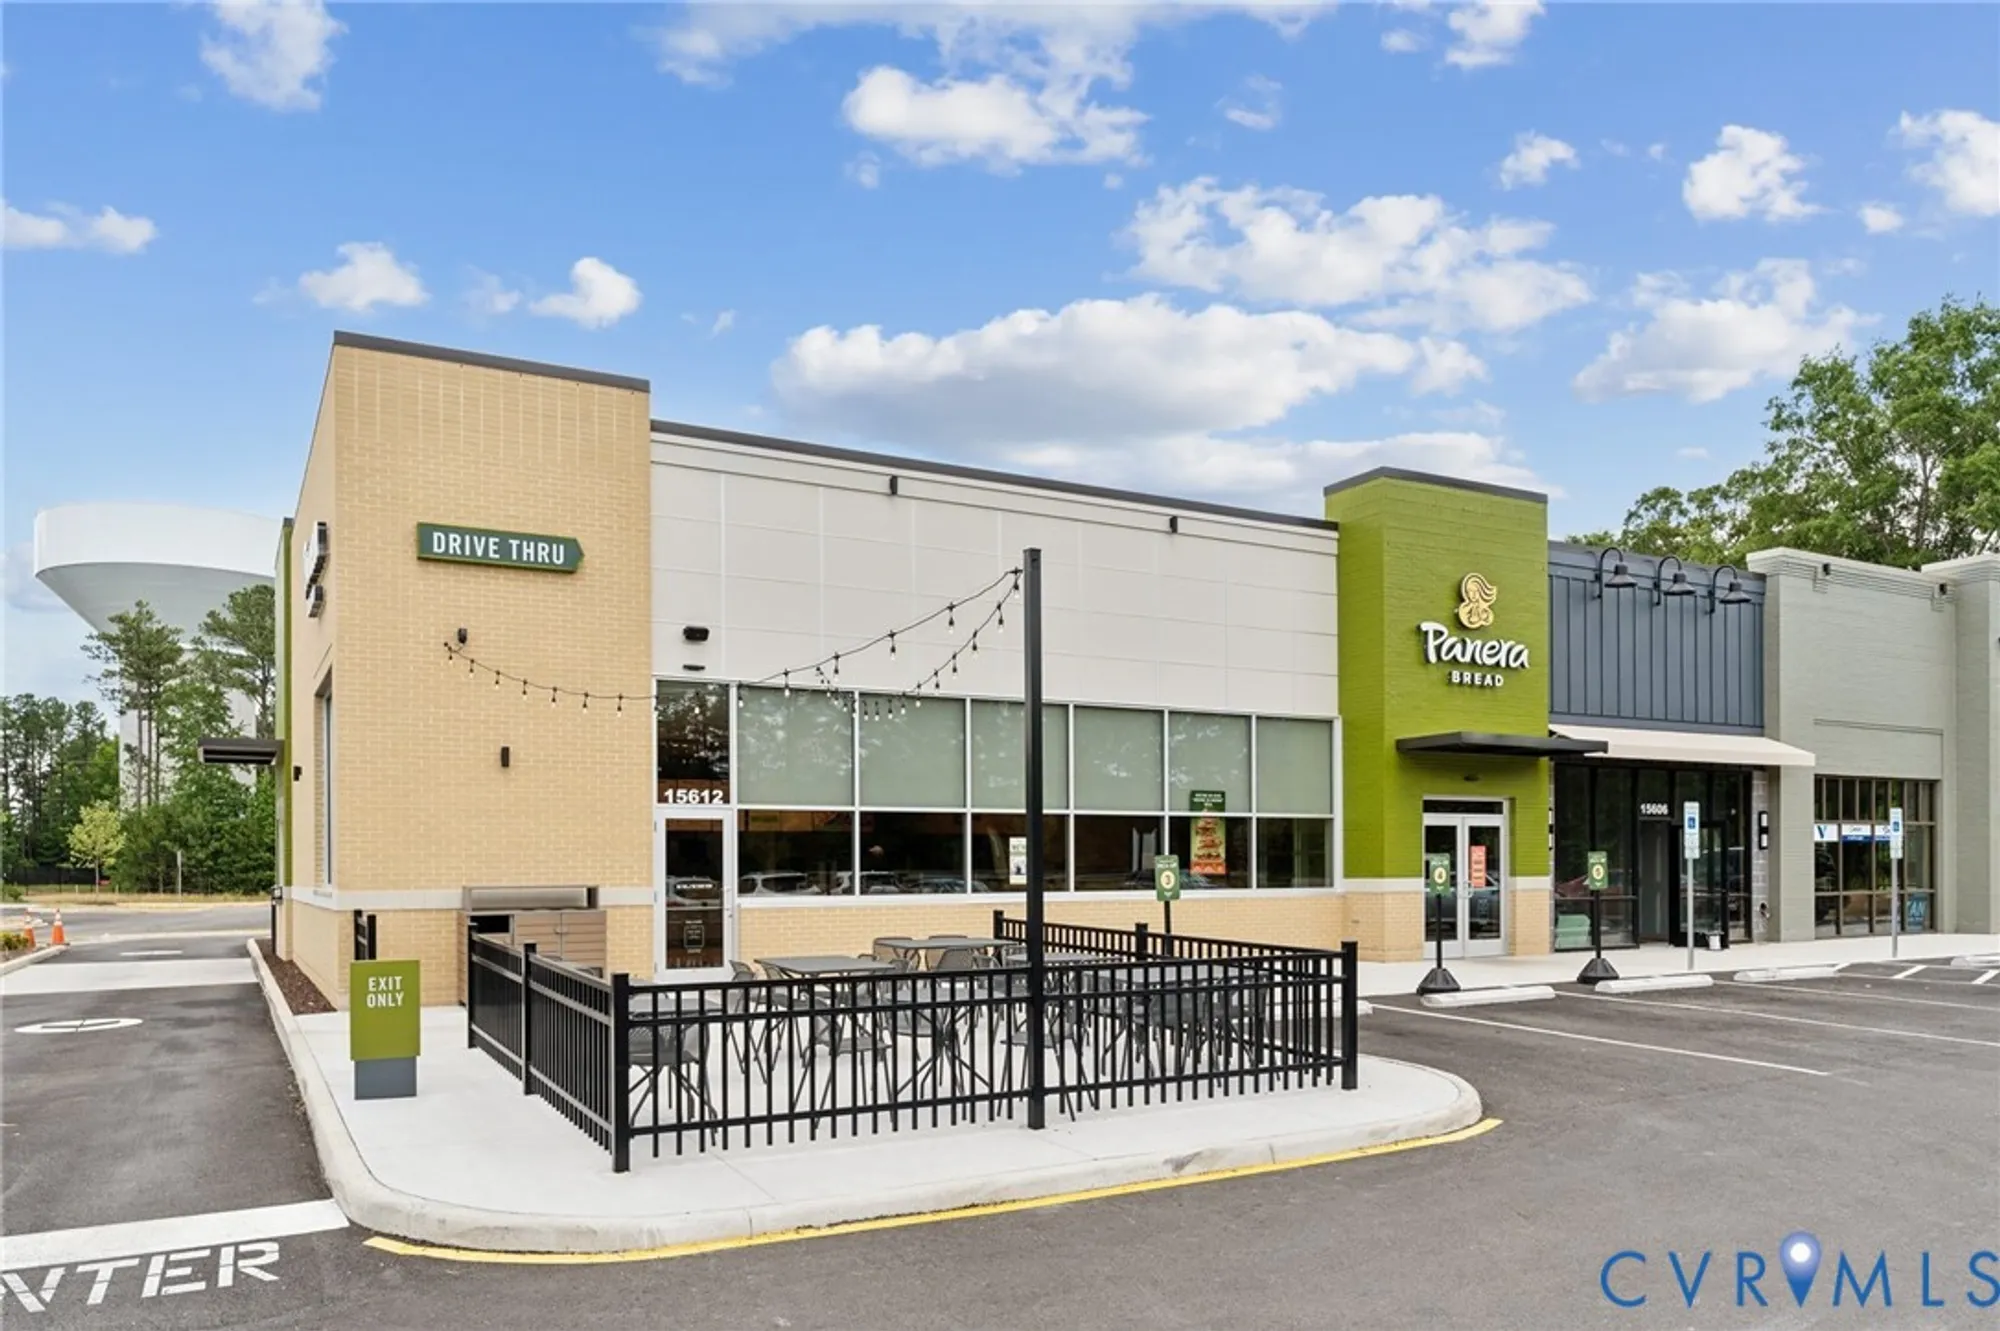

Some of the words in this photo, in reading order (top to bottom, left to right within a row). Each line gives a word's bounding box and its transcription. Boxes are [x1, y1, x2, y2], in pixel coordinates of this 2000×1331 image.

[432, 531, 500, 559] DRIVE
[508, 539, 566, 565] THRU
[1420, 621, 1530, 669] Panera
[1451, 670, 1504, 687] BREAD
[664, 788, 724, 804] 15612
[1640, 803, 1669, 815] 15606
[368, 976, 403, 992] EXIT
[366, 990, 405, 1008] ONLY
